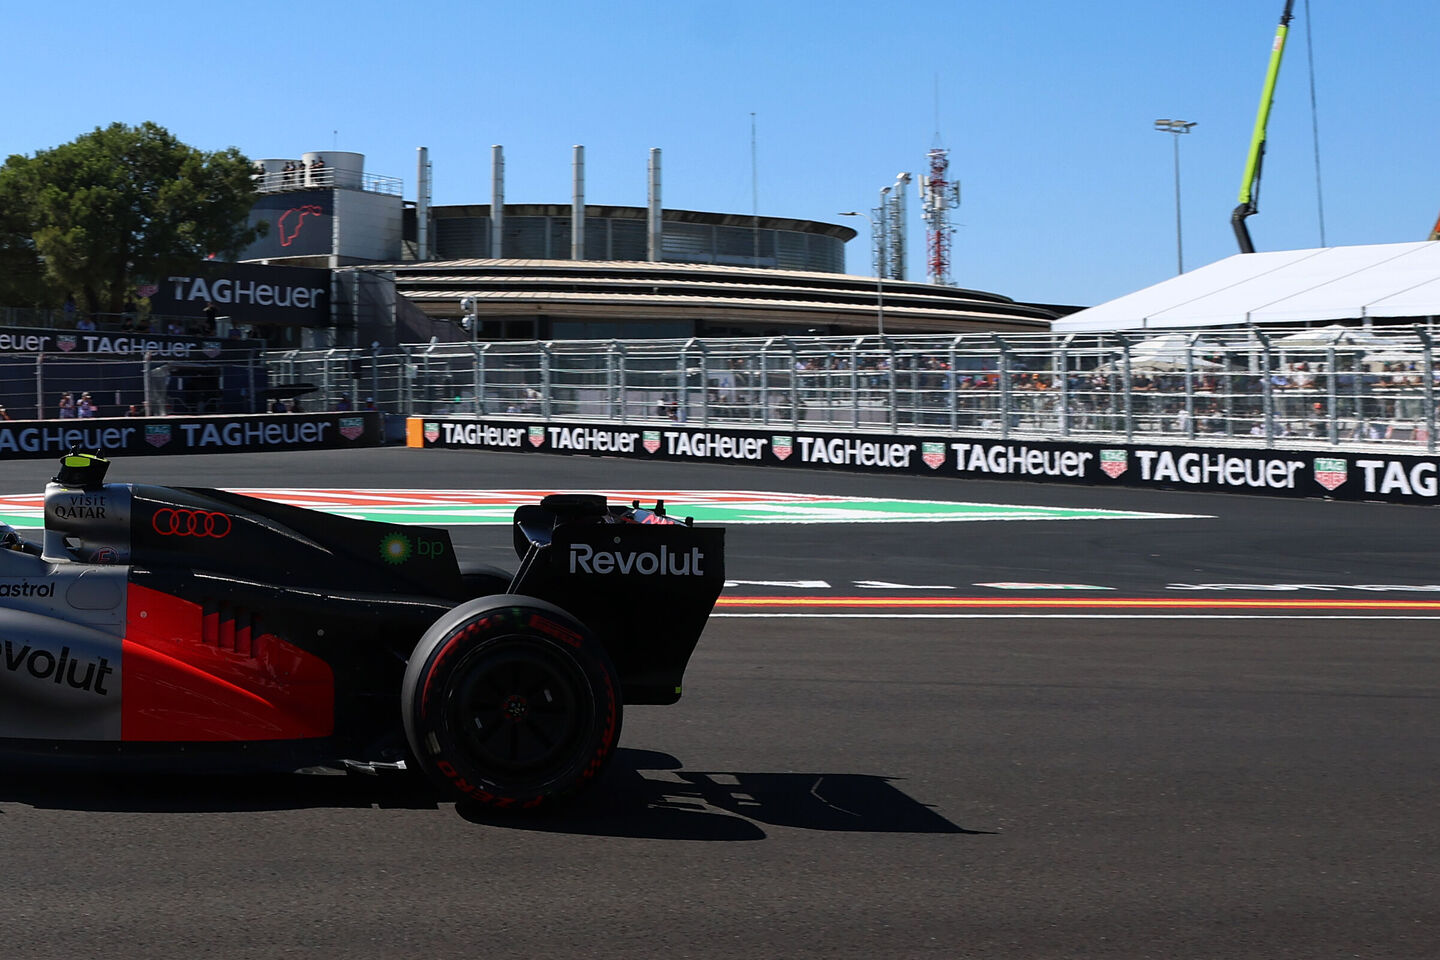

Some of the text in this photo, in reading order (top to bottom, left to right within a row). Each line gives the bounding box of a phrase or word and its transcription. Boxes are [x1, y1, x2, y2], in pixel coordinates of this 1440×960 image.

[168, 276, 325, 308] TAGHeuer
[180, 421, 331, 447] TAGHeuer
[442, 423, 527, 447] TAGHeuer
[548, 426, 640, 452] TAGHeuer
[664, 431, 768, 459] TAGHeuer
[796, 437, 917, 468] TAGHeuer
[950, 442, 1094, 478] TAGHeuer
[1134, 450, 1306, 489] TAGHeuer
[55, 505, 106, 520] QATAR
[71, 494, 106, 506] visit
[569, 543, 704, 576] Revolut
